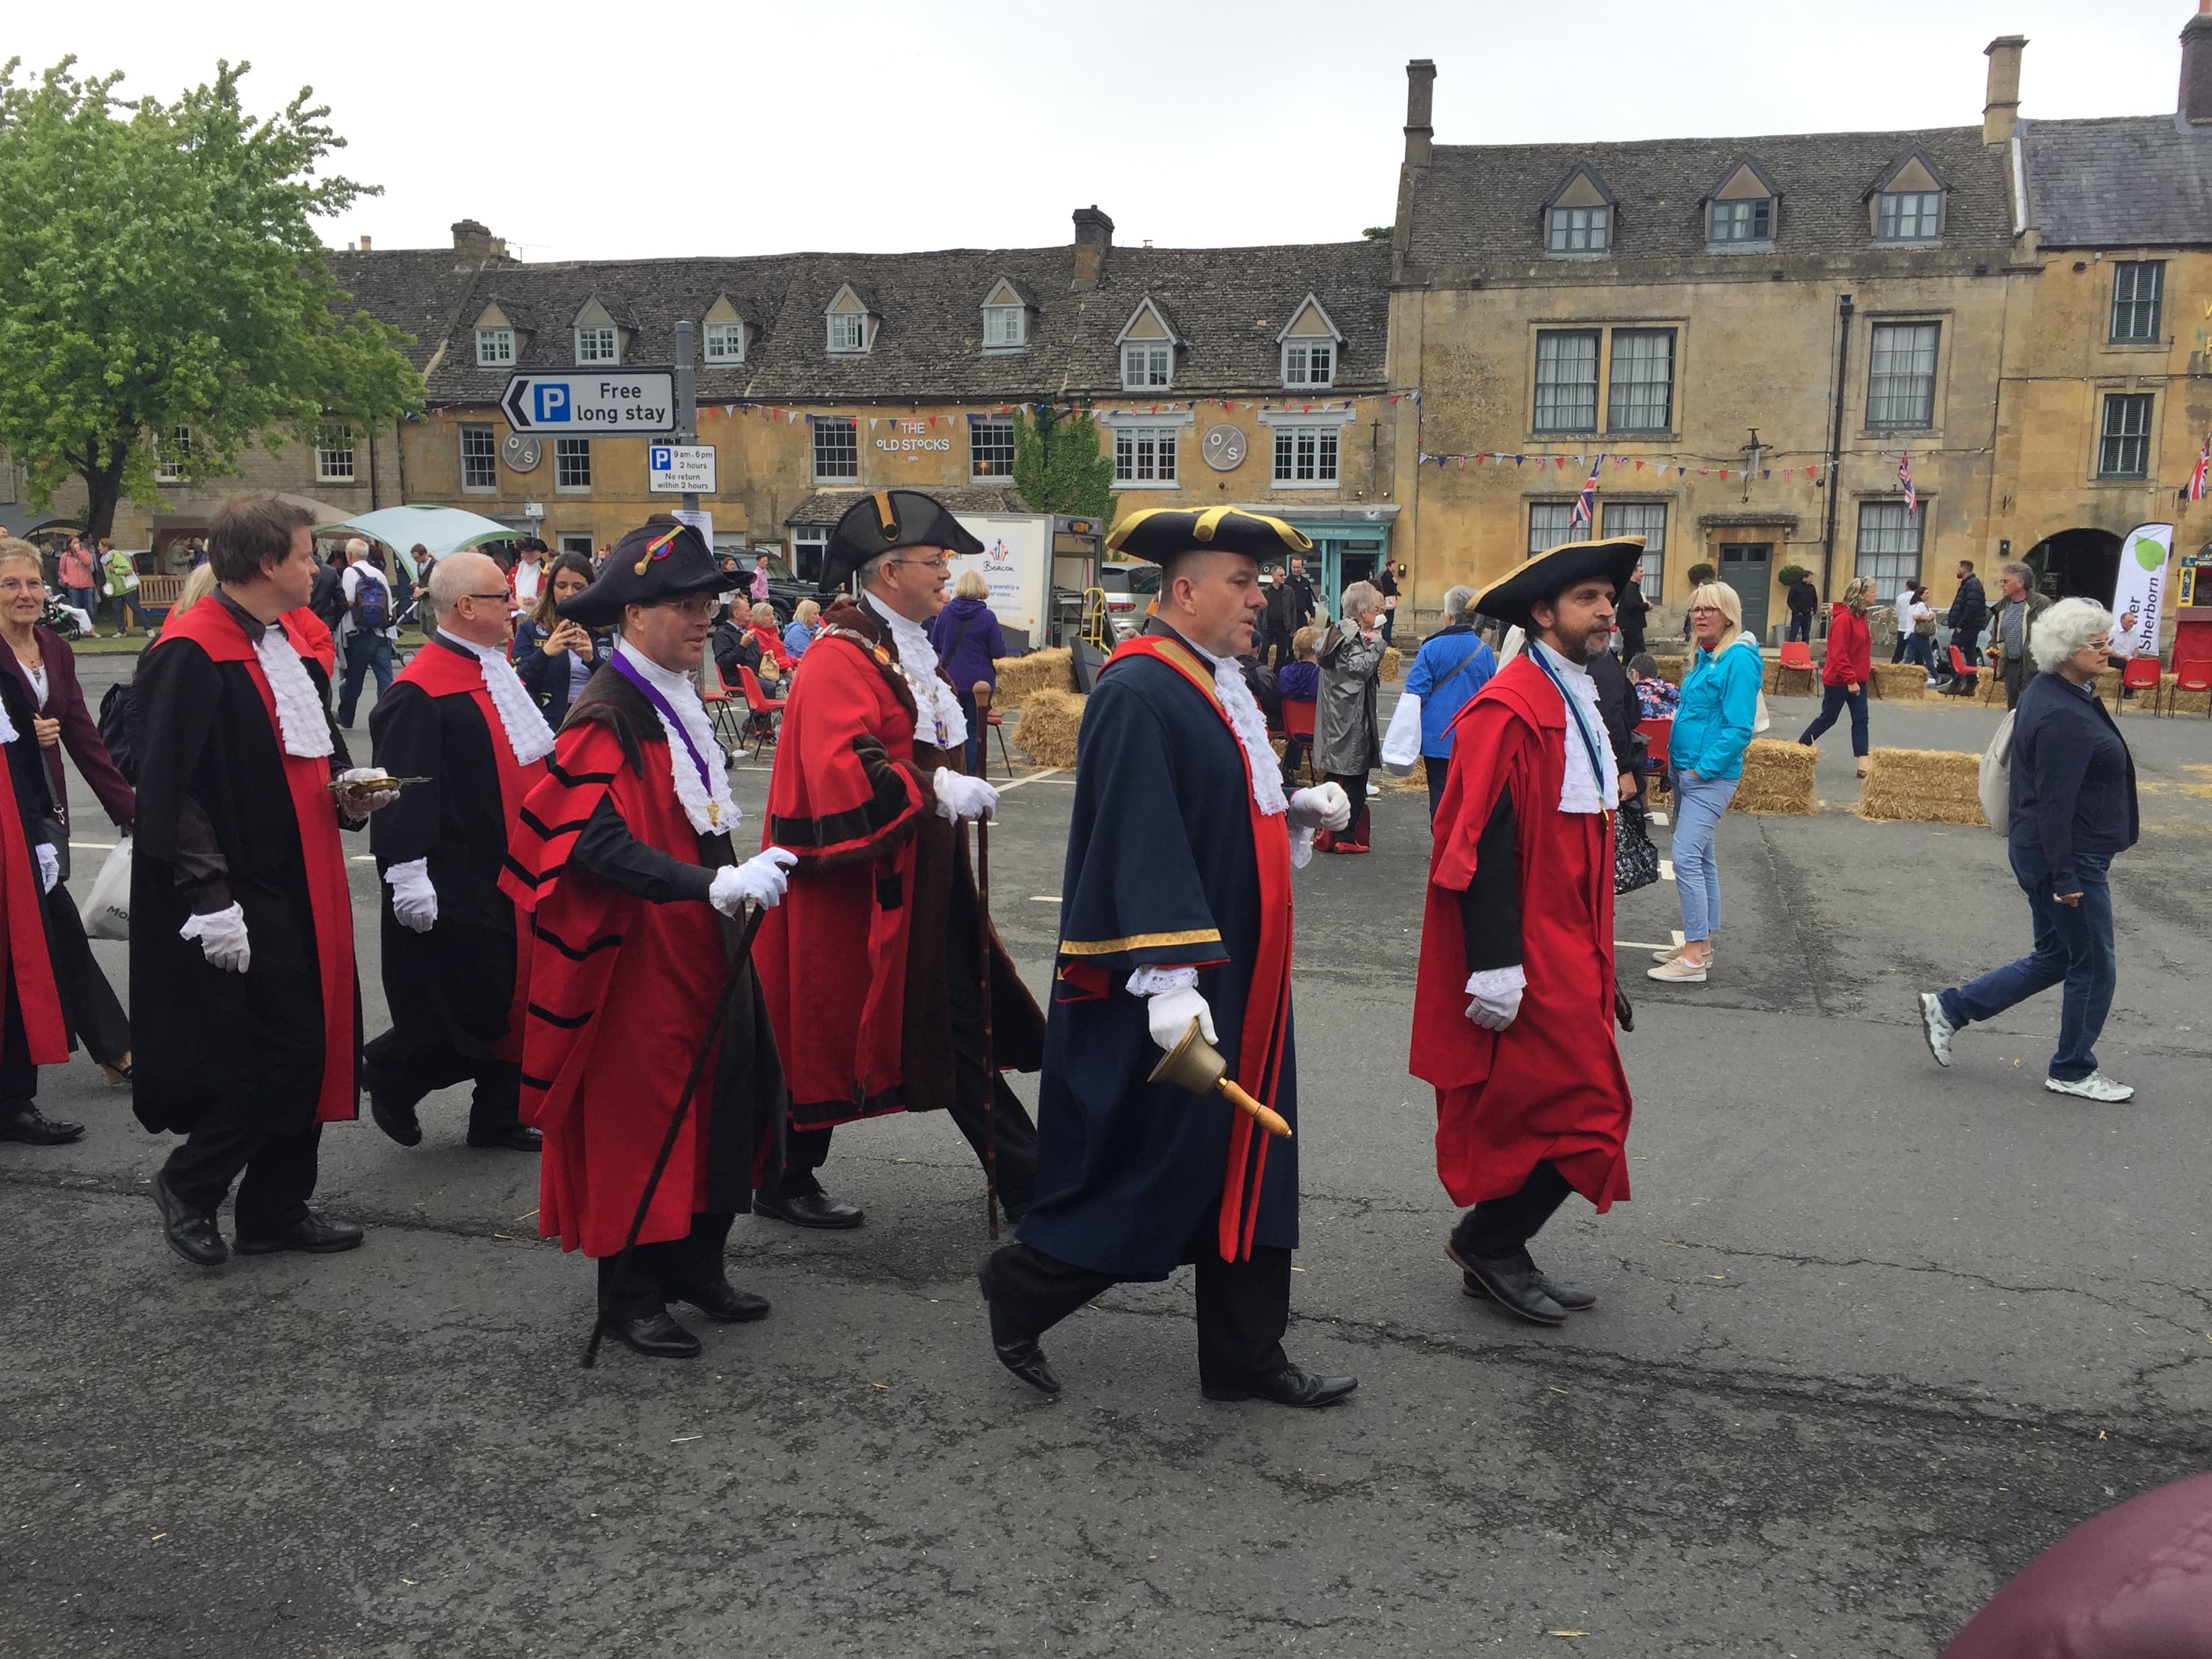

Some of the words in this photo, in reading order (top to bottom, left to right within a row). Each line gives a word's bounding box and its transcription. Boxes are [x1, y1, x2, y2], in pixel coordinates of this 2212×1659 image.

[600, 383, 642, 398] Free
[542, 388, 565, 419] P
[577, 405, 618, 424] long
[626, 405, 665, 423] stay
[901, 422, 925, 434] THE
[876, 438, 899, 451] OLD
[902, 438, 949, 451] STOCKS
[656, 451, 668, 469] P
[983, 560, 1015, 572] Beacon
[2138, 577, 2158, 651] Sherborn
[106, 905, 130, 922] Mo
